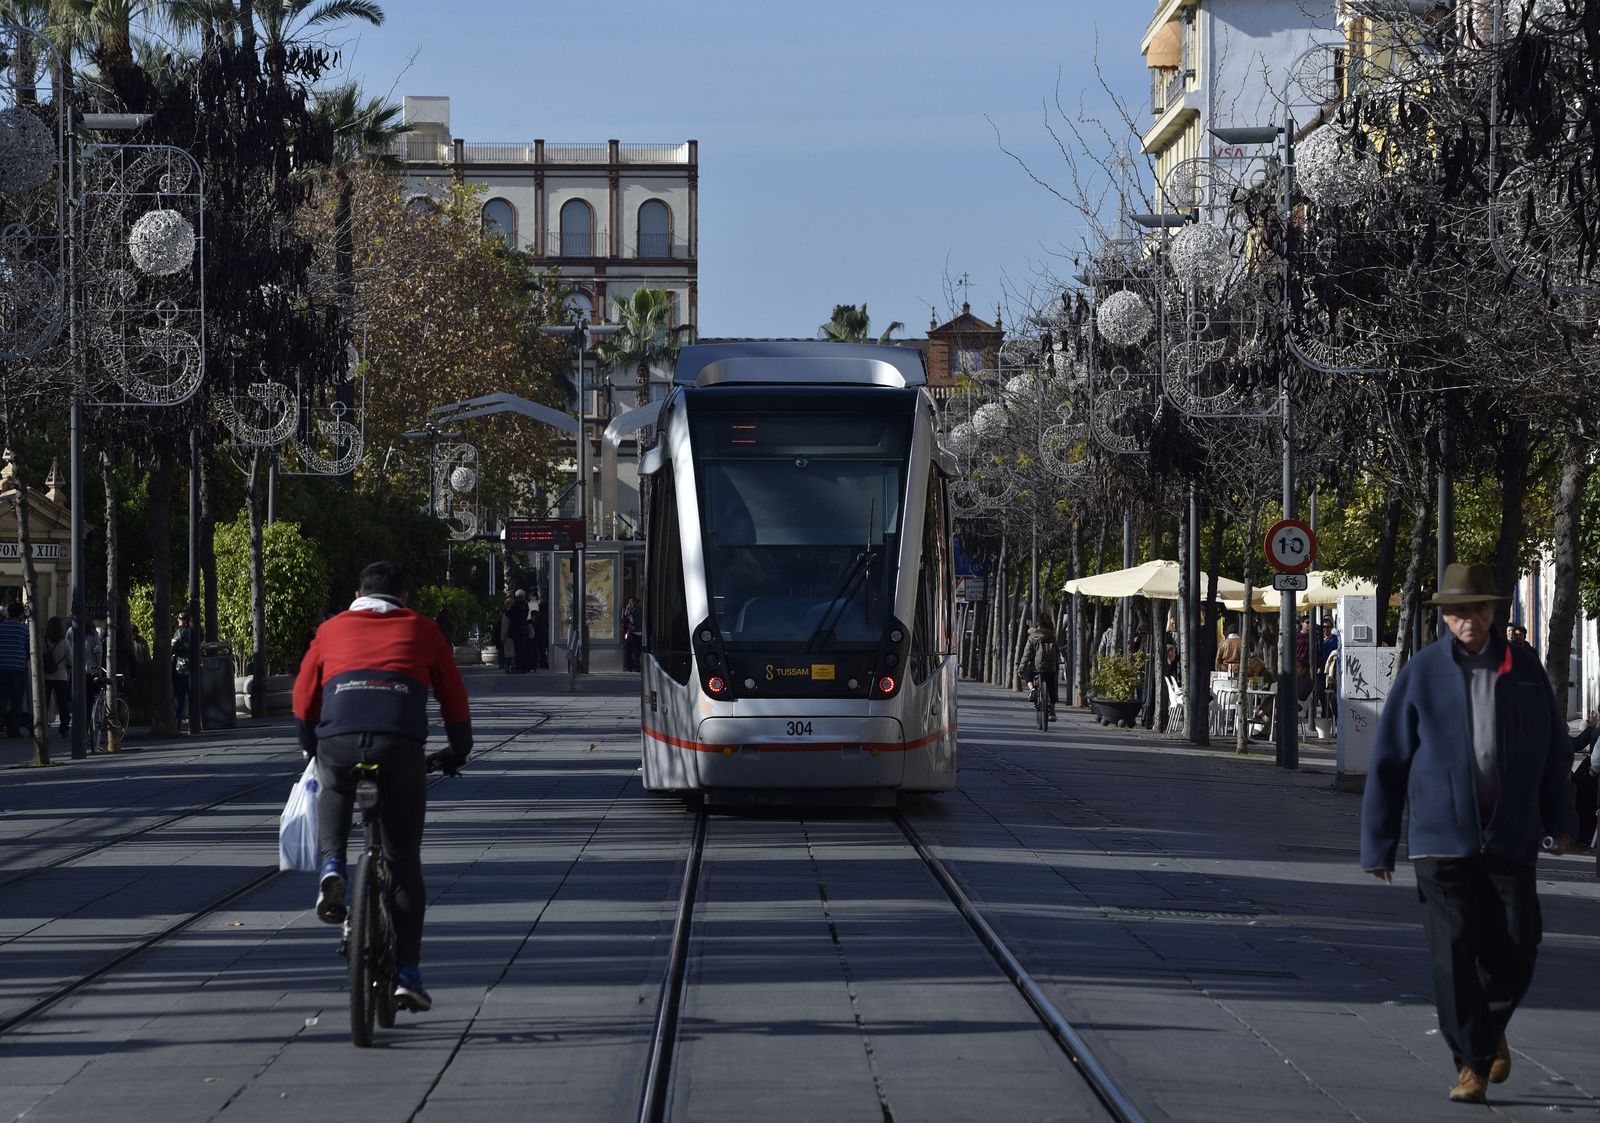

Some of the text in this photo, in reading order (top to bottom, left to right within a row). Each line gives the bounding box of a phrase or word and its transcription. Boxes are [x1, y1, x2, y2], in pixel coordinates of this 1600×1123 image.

[37, 545, 58, 557] XIII
[1279, 537, 1304, 554] 10
[776, 668, 809, 676] TUSSAM
[786, 721, 813, 736] 304
